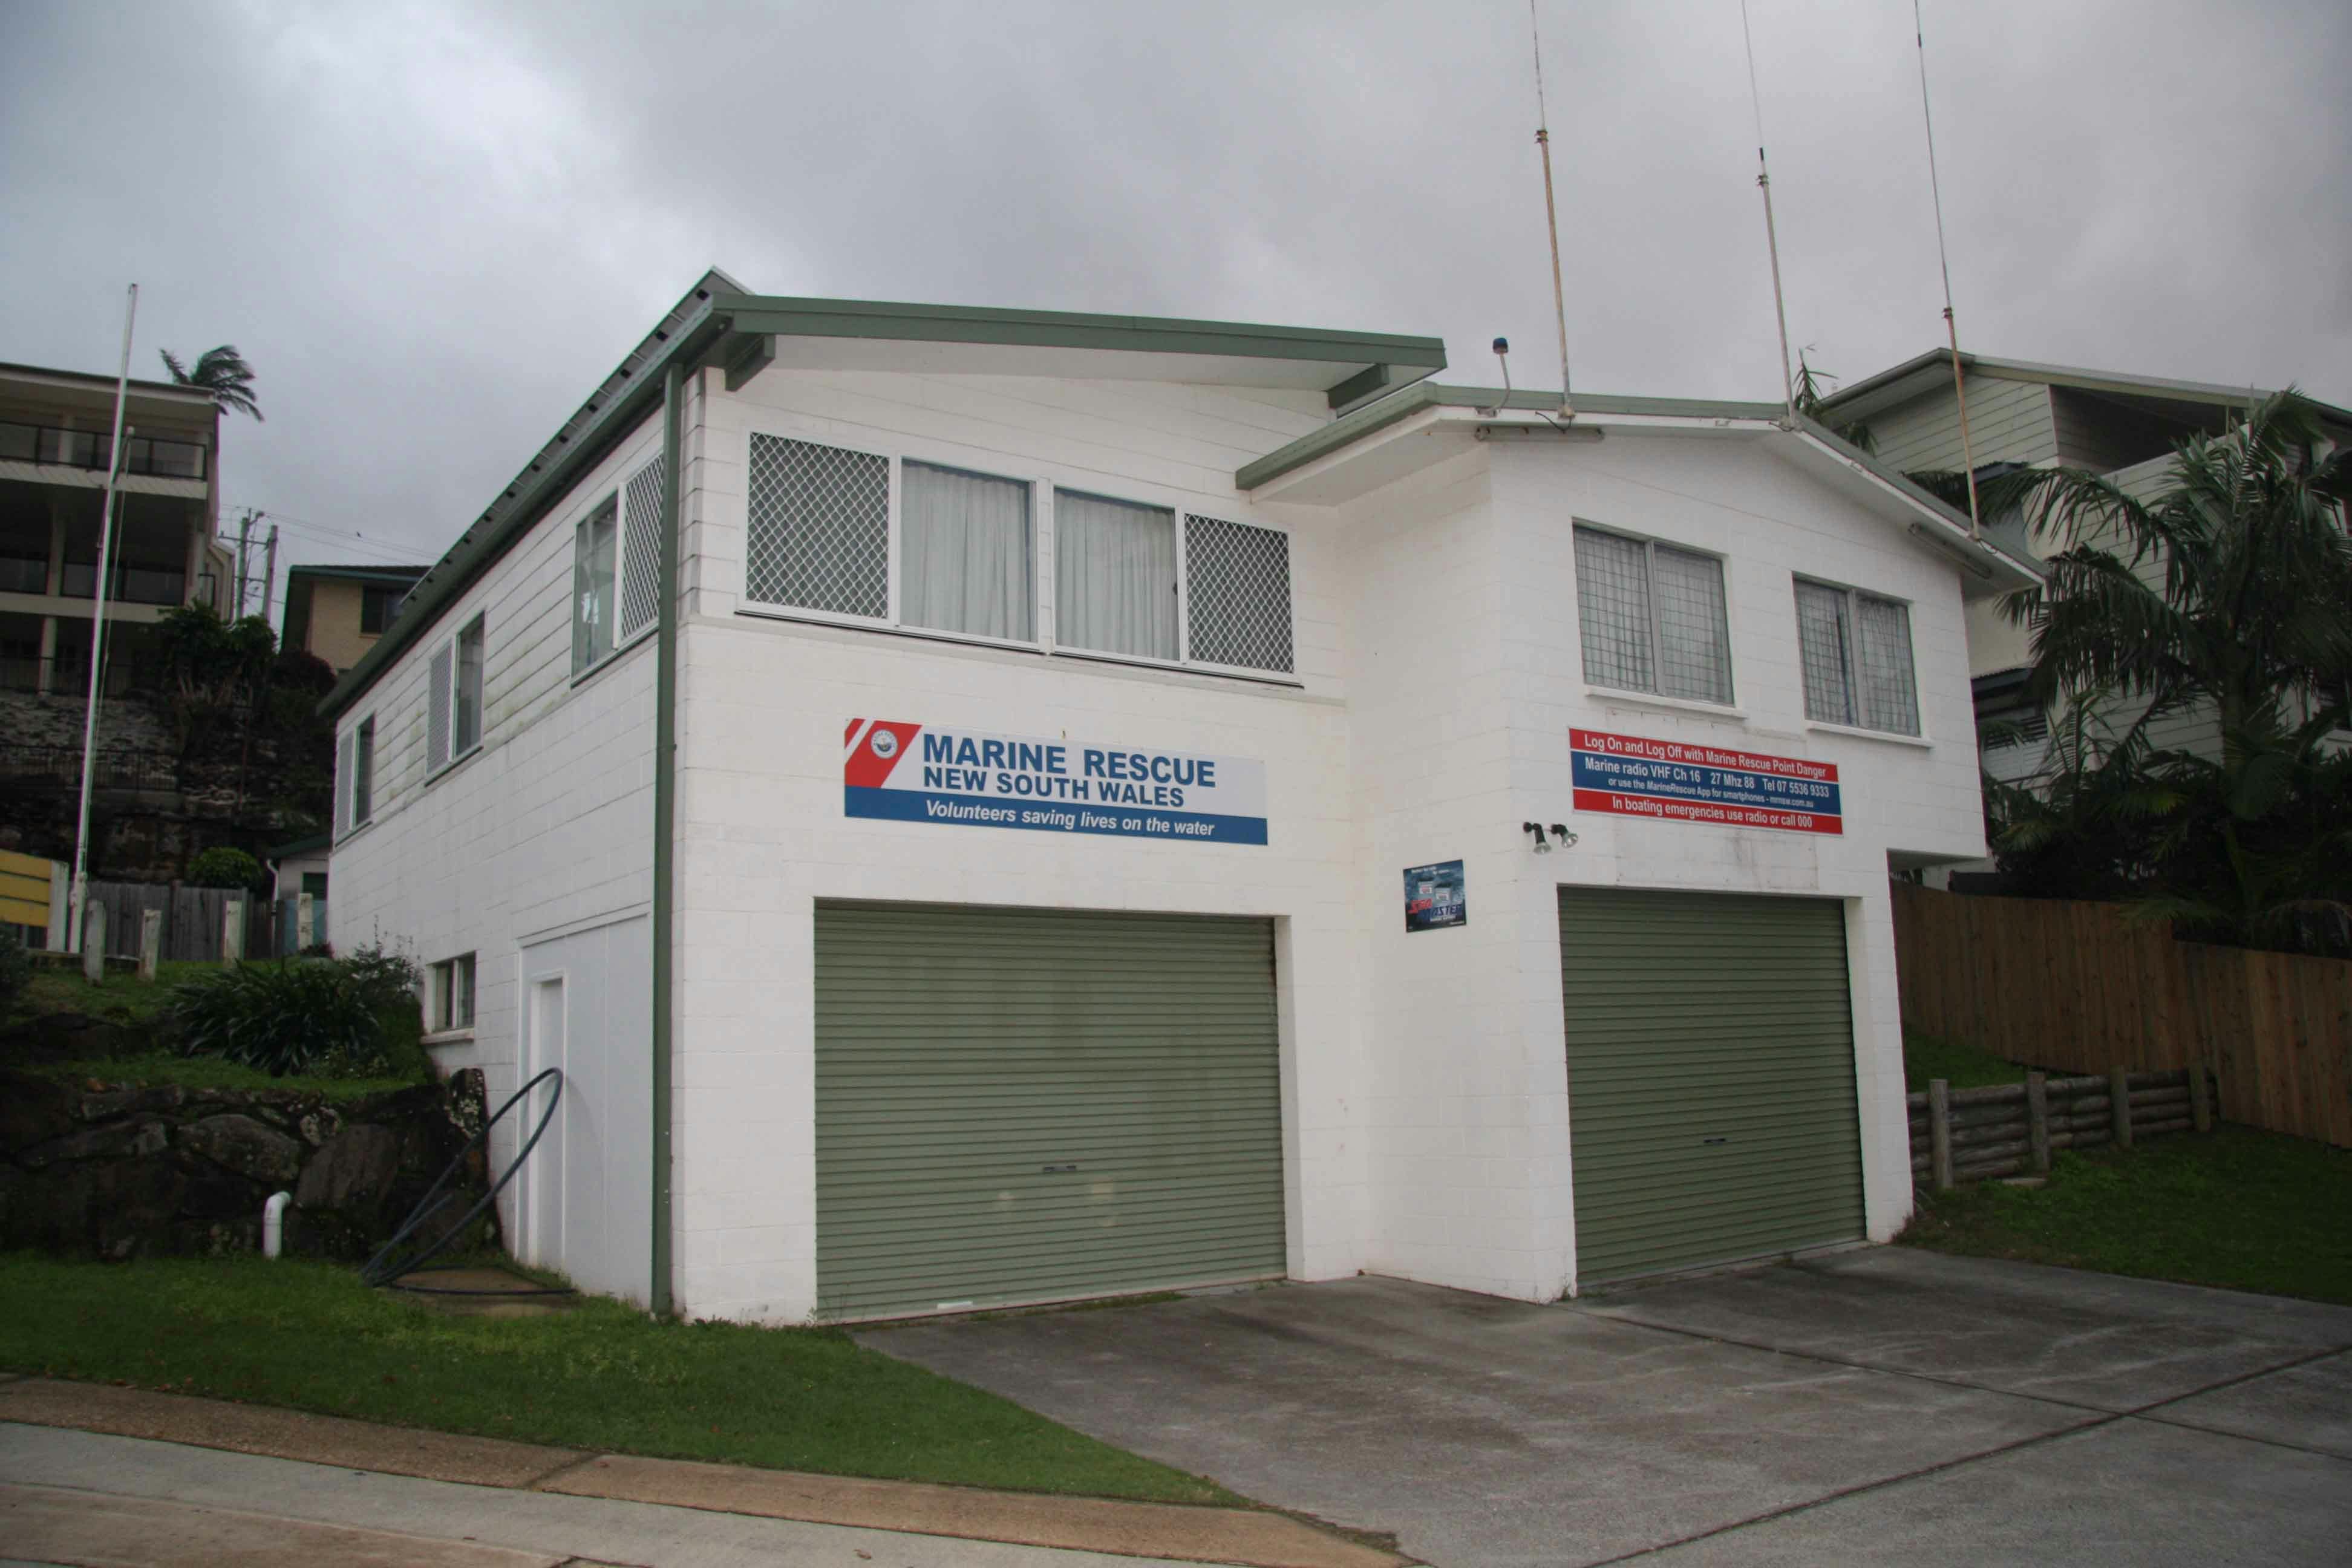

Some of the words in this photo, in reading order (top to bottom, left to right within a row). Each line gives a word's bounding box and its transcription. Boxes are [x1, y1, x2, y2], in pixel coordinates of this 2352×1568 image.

[924, 733, 1067, 774] MARINE
[1084, 749, 1215, 787] RESCUE
[1584, 734, 1604, 751] Log
[1607, 737, 1622, 751] On
[1625, 742, 1643, 754] and
[1646, 742, 1665, 759] Log
[1667, 745, 1682, 759] Off
[1684, 748, 1704, 762] with
[1706, 751, 1736, 766] Marine
[1739, 754, 1771, 770] Rescue
[1772, 759, 1795, 774] Point
[1797, 762, 1826, 779] Danger
[1585, 756, 1620, 773] Marine
[1622, 763, 1648, 776] radio
[1650, 765, 1671, 779] VHF
[1673, 768, 1687, 781] Ch
[1690, 769, 1700, 783] 16
[1710, 772, 1721, 785] 27
[1723, 774, 1742, 787] Mhz
[1743, 776, 1754, 789] 88
[1763, 778, 1775, 791] Tel
[1777, 780, 1786, 792] 07
[1789, 782, 1809, 795] 5536
[1809, 784, 1829, 798] 9333
[924, 766, 987, 791] NEW
[997, 772, 1089, 800] SOUTH
[1098, 781, 1184, 807] WALES
[1618, 779, 1632, 788] use
[1633, 780, 1645, 789] the
[1697, 786, 1711, 798] App
[1711, 788, 1722, 797] for
[1723, 790, 1765, 803] smartphones
[926, 800, 1016, 822] Volunteers
[1022, 810, 1075, 829] saving
[1080, 812, 1117, 829] lives
[1122, 818, 1141, 830] on
[1146, 818, 1170, 832] the
[1175, 821, 1215, 835] water
[1612, 795, 1622, 809] In
[1624, 797, 1663, 816] boating
[1665, 803, 1724, 819] emergencies
[1727, 811, 1743, 821] use
[1745, 811, 1768, 823] radio
[1769, 815, 1779, 825] or
[1781, 814, 1795, 826] call
[1797, 815, 1812, 828] 000
